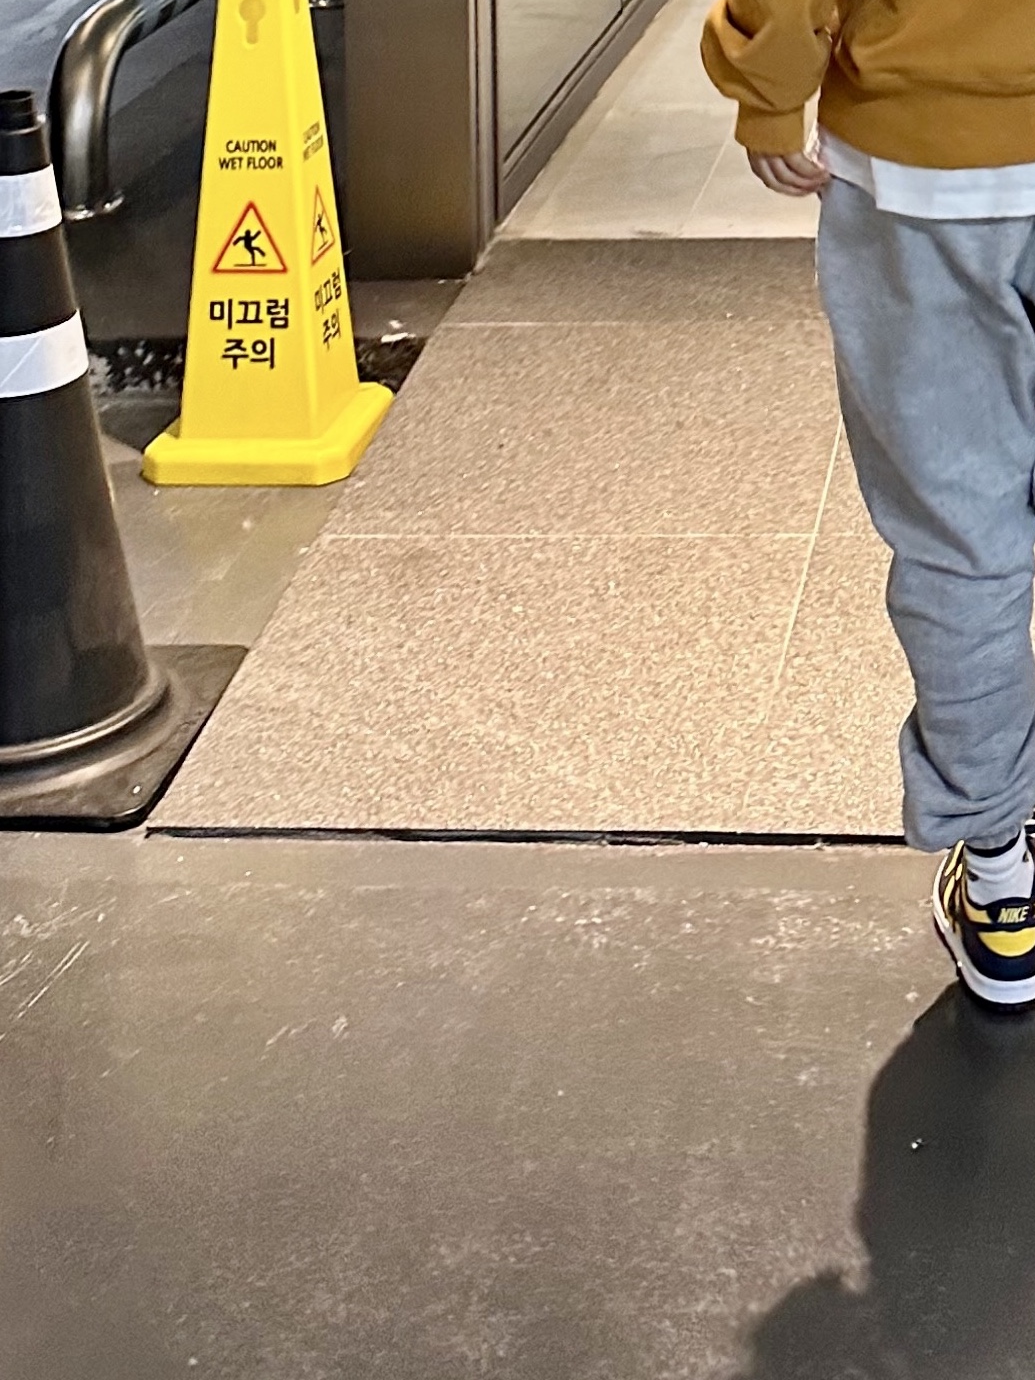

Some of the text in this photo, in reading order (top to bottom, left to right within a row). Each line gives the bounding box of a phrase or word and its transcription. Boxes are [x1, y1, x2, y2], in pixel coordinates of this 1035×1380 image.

[225, 139, 277, 154] CAUTION
[218, 156, 283, 170] WET FLOOR
[209, 297, 289, 330] 미끄럼
[221, 336, 275, 371] 주의
[997, 905, 1030, 923] NIKE
